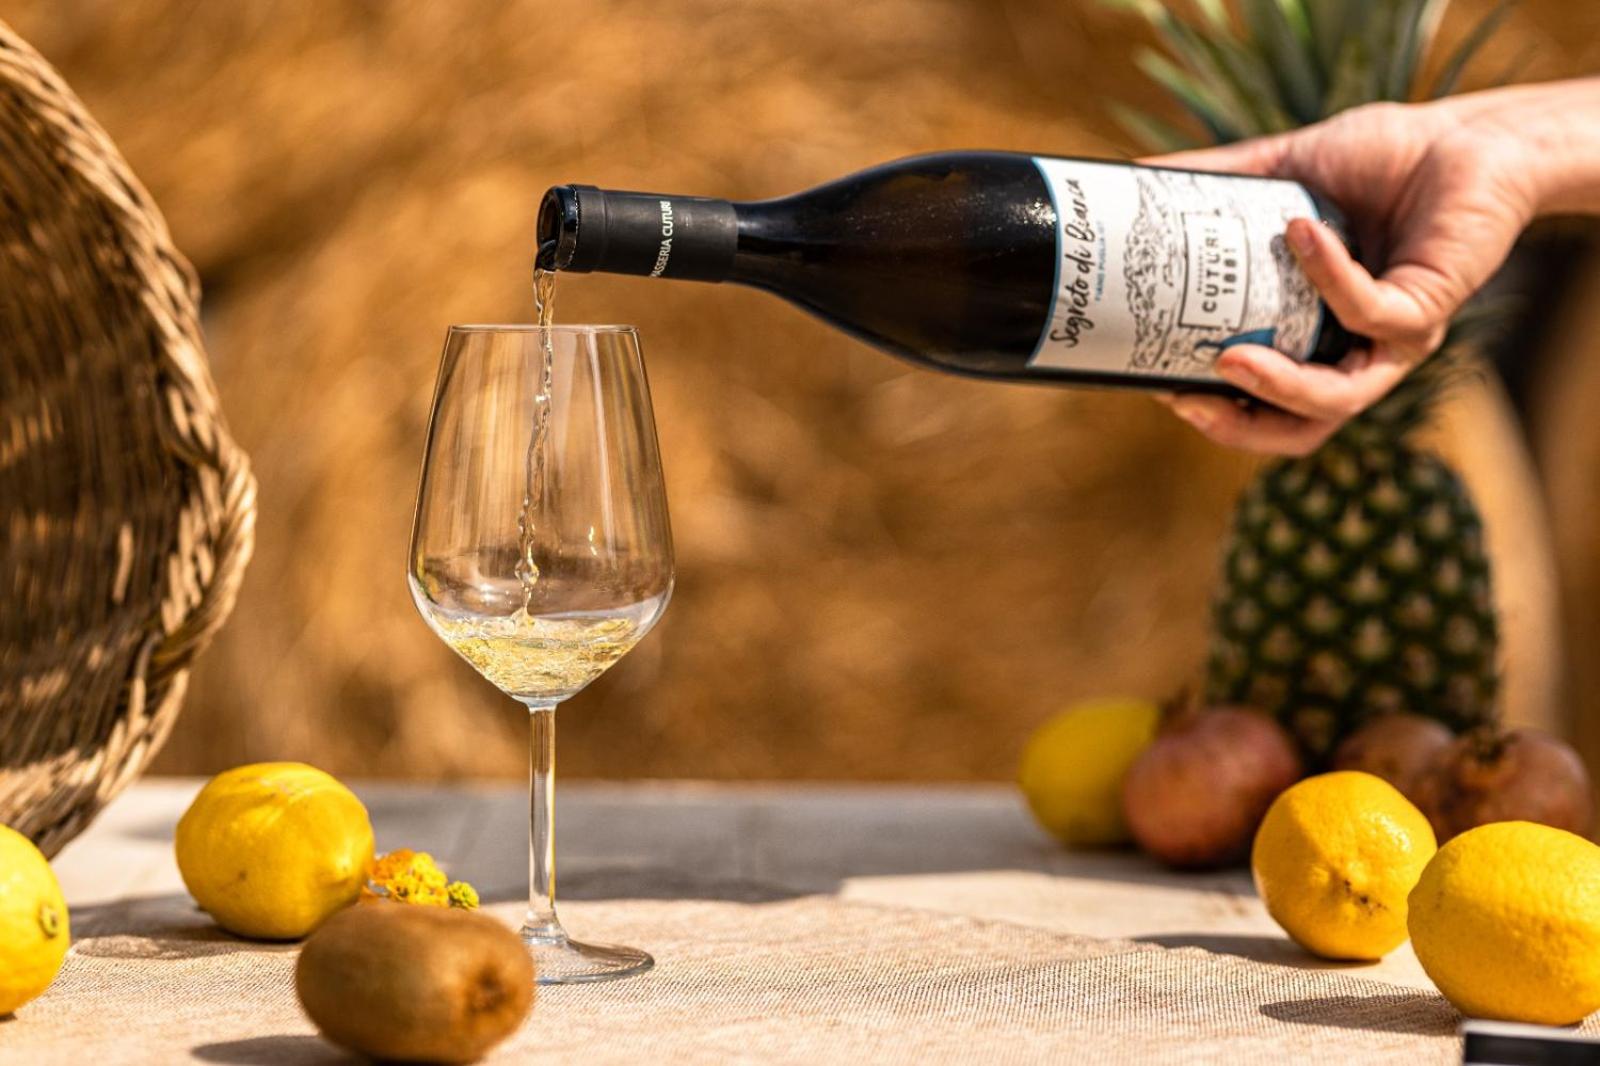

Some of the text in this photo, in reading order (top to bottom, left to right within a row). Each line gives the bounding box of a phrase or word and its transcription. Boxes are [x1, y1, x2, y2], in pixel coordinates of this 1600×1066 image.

[660, 200, 673, 236] CUTURI
[1049, 178, 1096, 348] Segreto di Bianca
[1202, 227, 1221, 313] CUTURI
